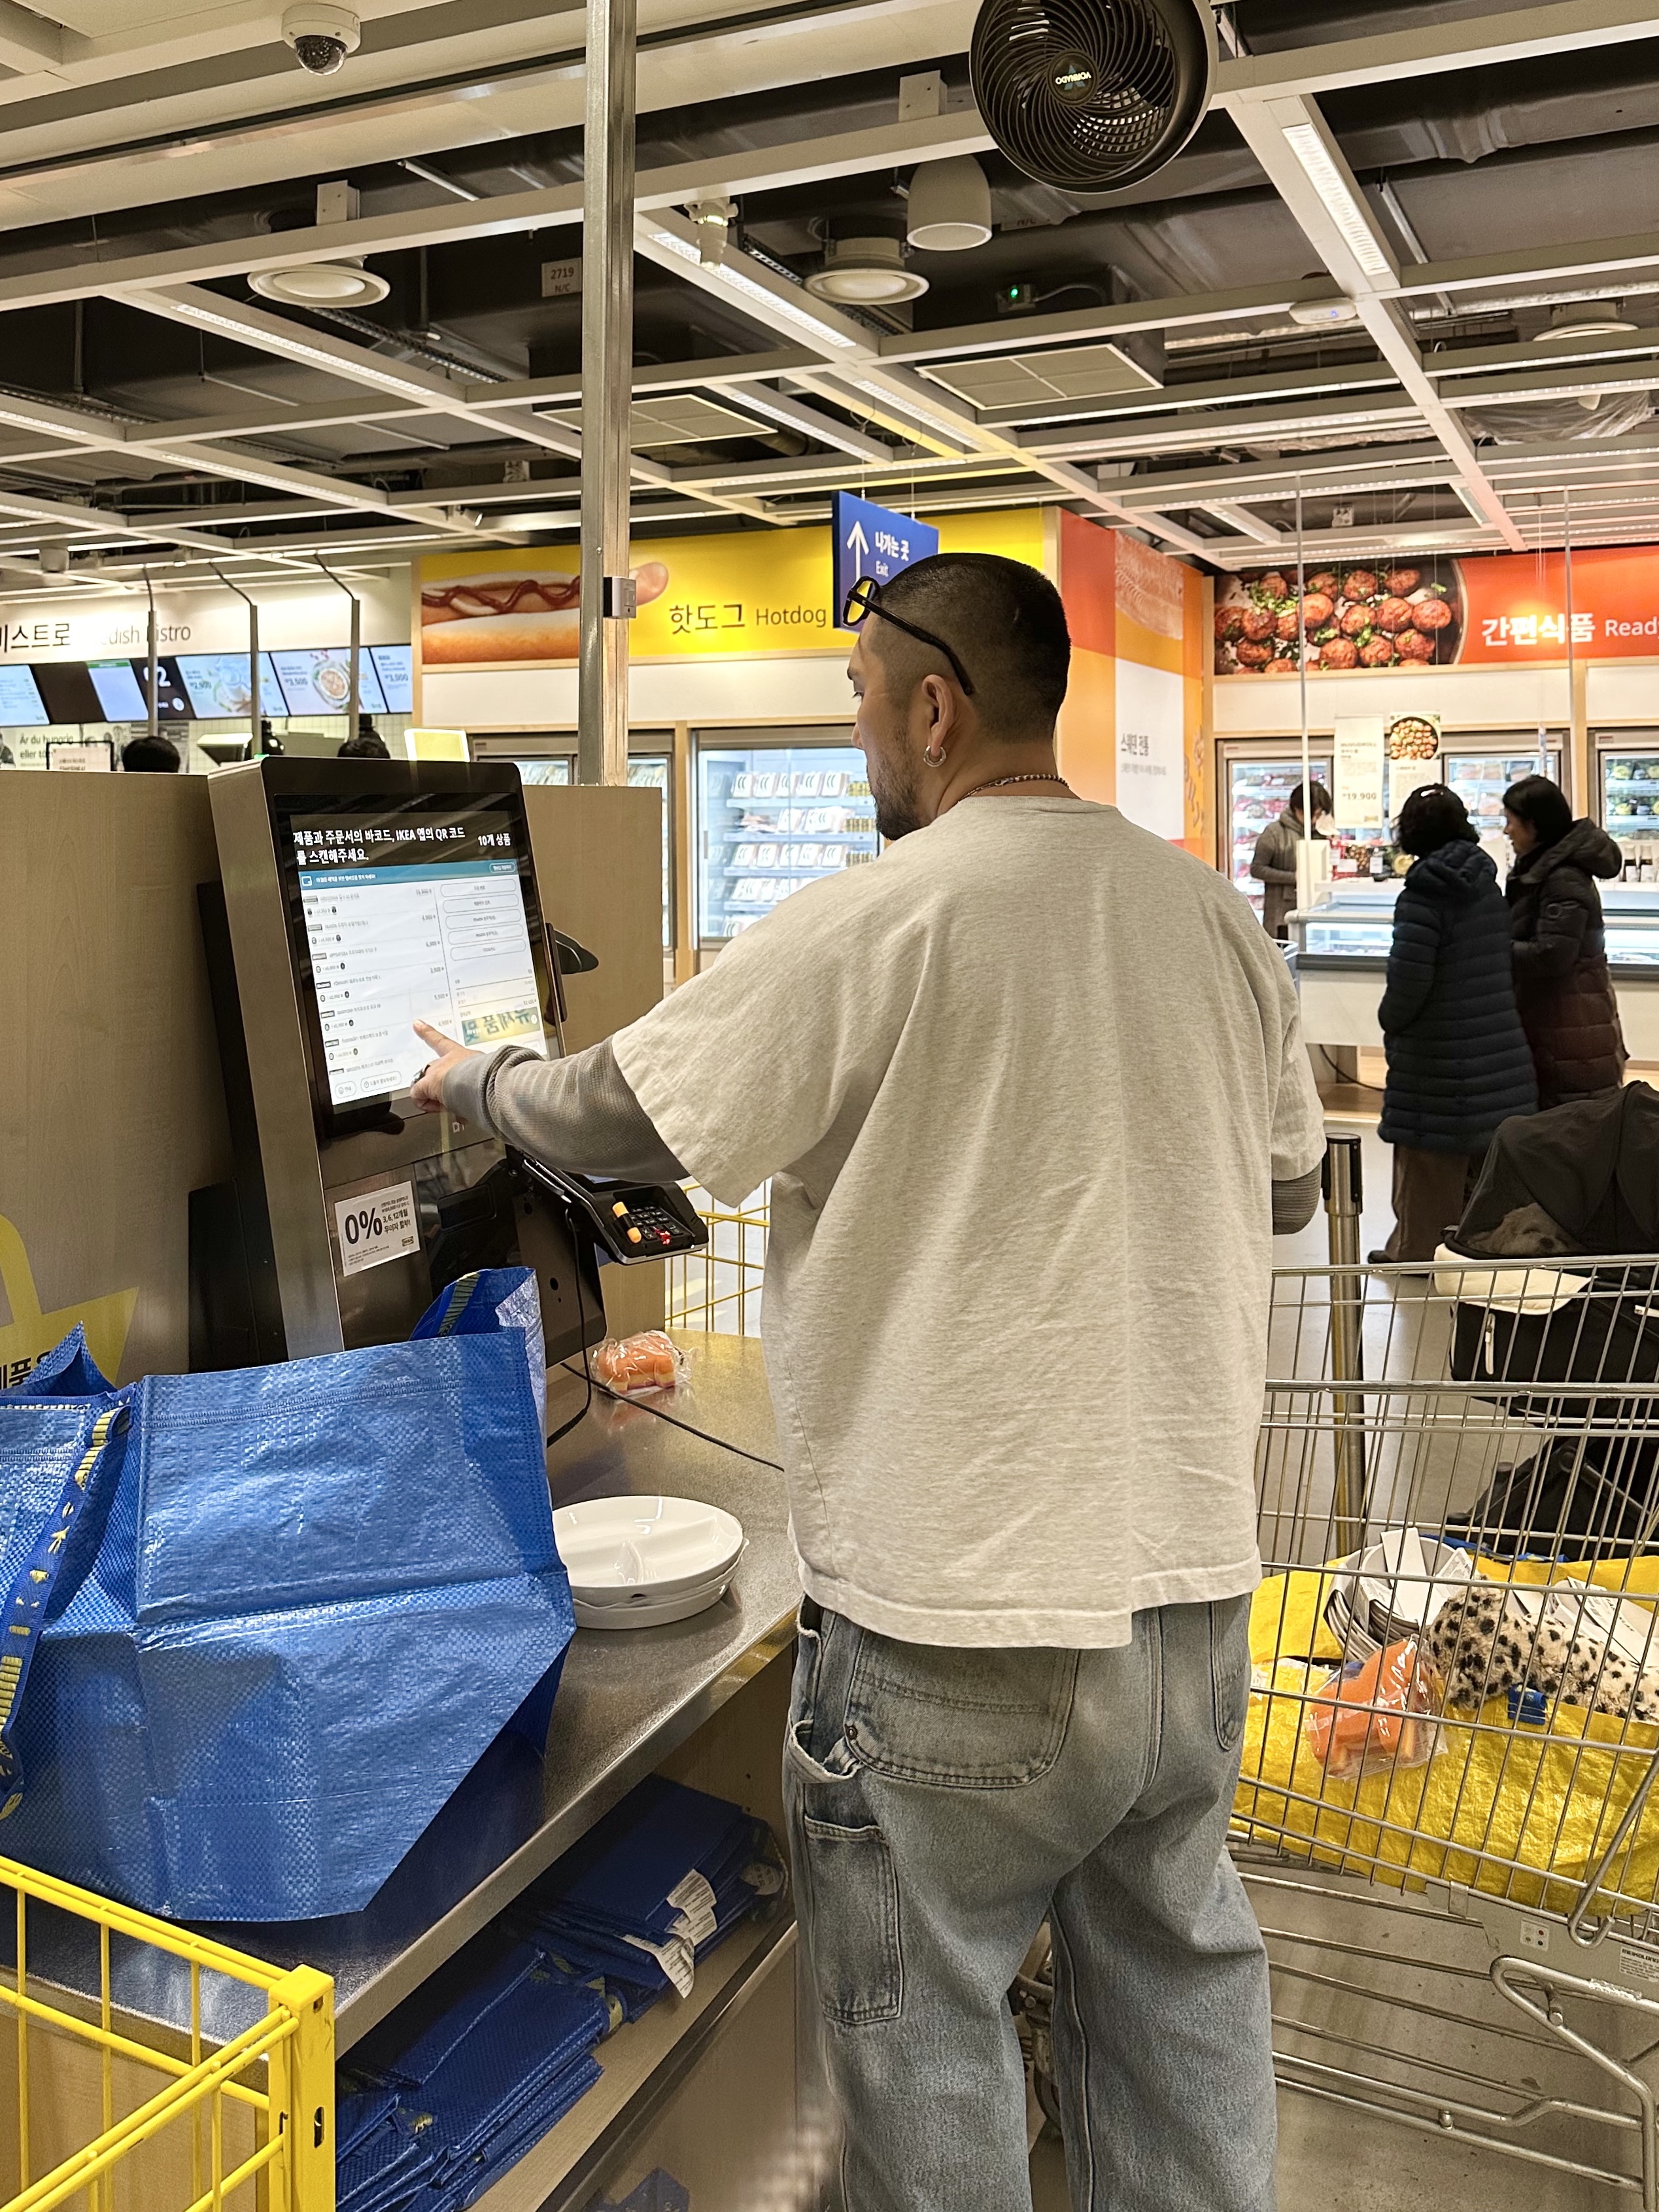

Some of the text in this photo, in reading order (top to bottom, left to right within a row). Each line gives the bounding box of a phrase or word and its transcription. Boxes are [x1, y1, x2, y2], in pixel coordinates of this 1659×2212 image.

[1055, 71, 1091, 85] VORNADO
[551, 266, 574, 280] 2719
[875, 531, 910, 561] 나가는 곳
[876, 560, 889, 577] Exit
[669, 604, 827, 634] 핫도그 Hotdog
[1481, 612, 1596, 647] 간편식품
[293, 827, 466, 846] 제품과 주문서의 바코드, IKEA 앱의 QR 코드
[478, 833, 511, 846] 10개 상품
[296, 848, 369, 865] 를 스캔해주세요.
[345, 1207, 383, 1244] 0%
